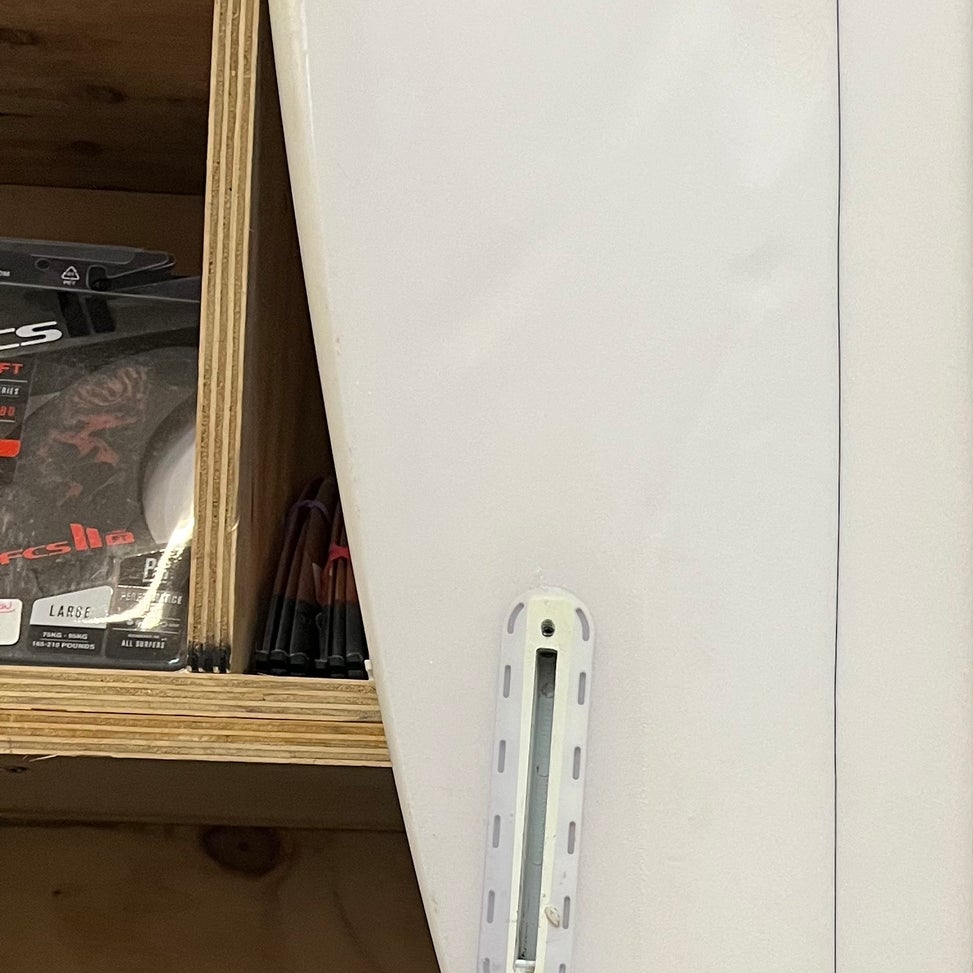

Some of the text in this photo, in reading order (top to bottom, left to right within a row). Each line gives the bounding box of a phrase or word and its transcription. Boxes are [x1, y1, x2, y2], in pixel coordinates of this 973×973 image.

[120, 591, 184, 605] PERFNCE
[49, 604, 92, 619] LARGE
[61, 642, 96, 650] POUNDS
[121, 639, 166, 650] ALL SURFERS
